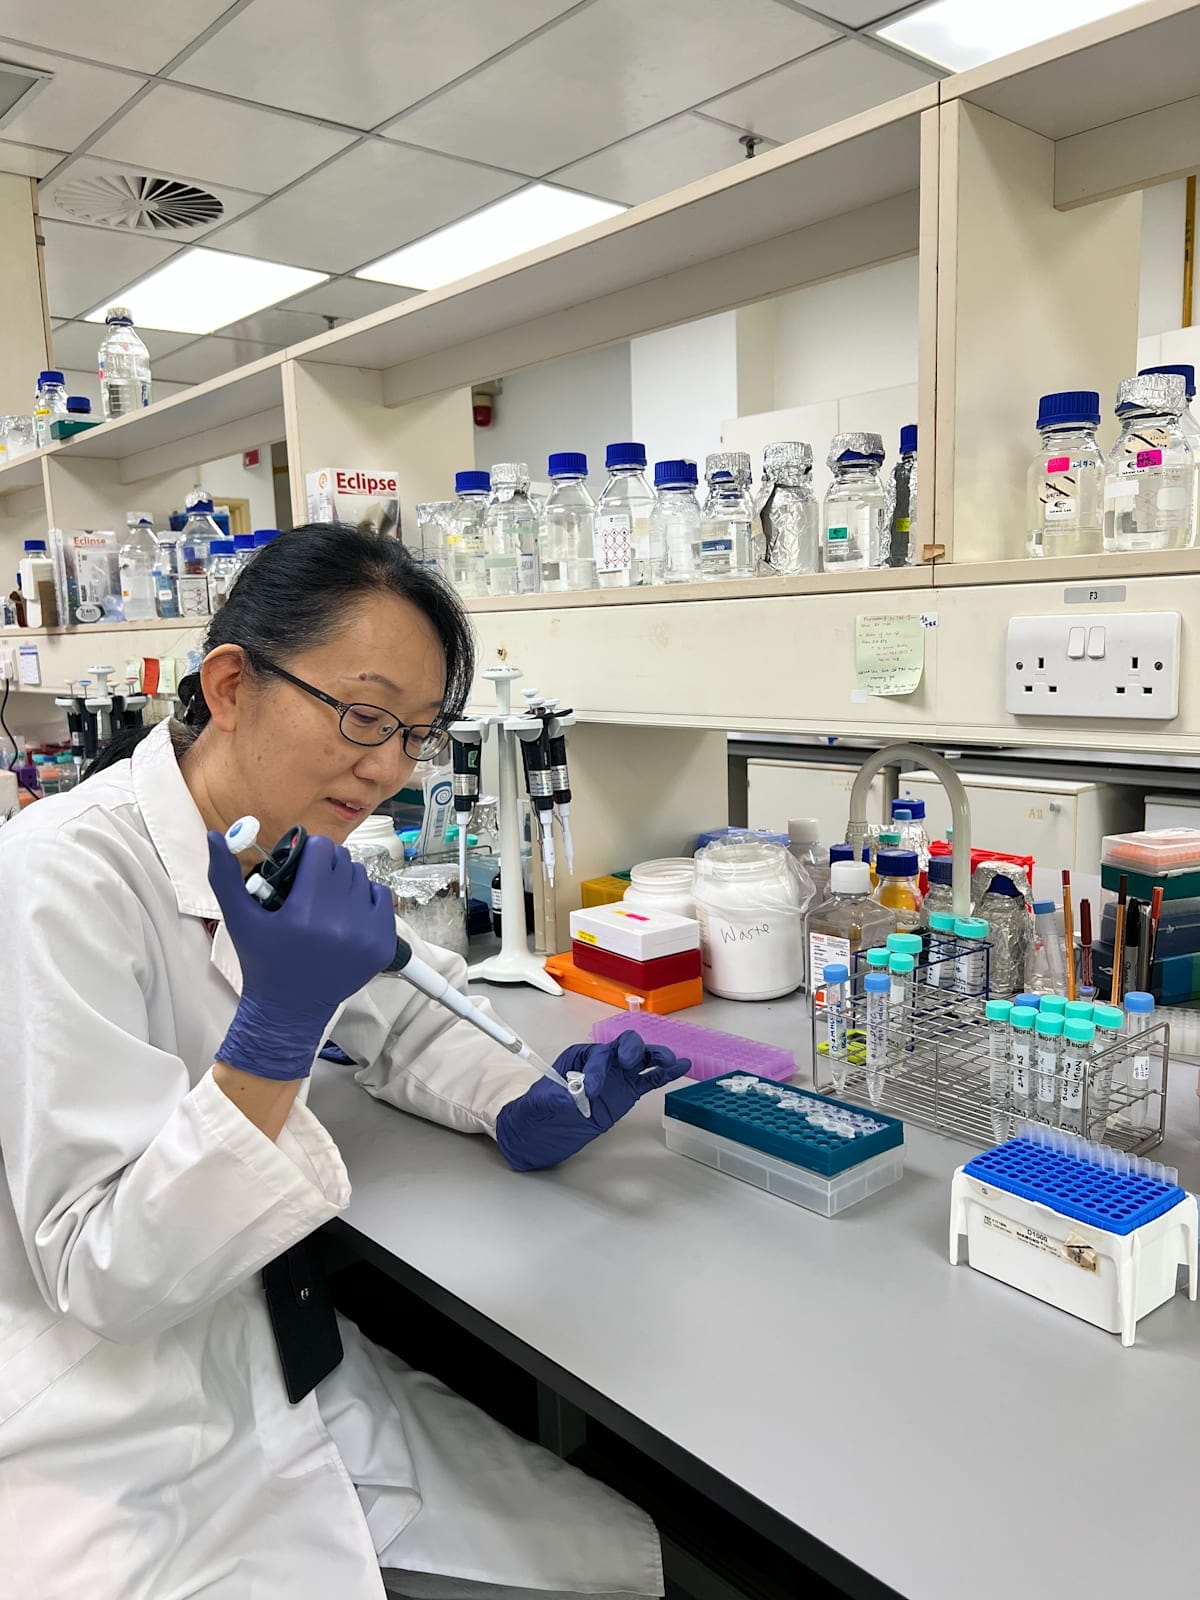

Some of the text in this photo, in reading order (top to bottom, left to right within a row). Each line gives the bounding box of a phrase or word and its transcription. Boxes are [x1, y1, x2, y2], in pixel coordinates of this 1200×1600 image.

[336, 472, 397, 494] Eclipse
[1089, 591, 1098, 600] F3
[720, 923, 770, 944] Waste
[1027, 1229, 1049, 1243] D1000
